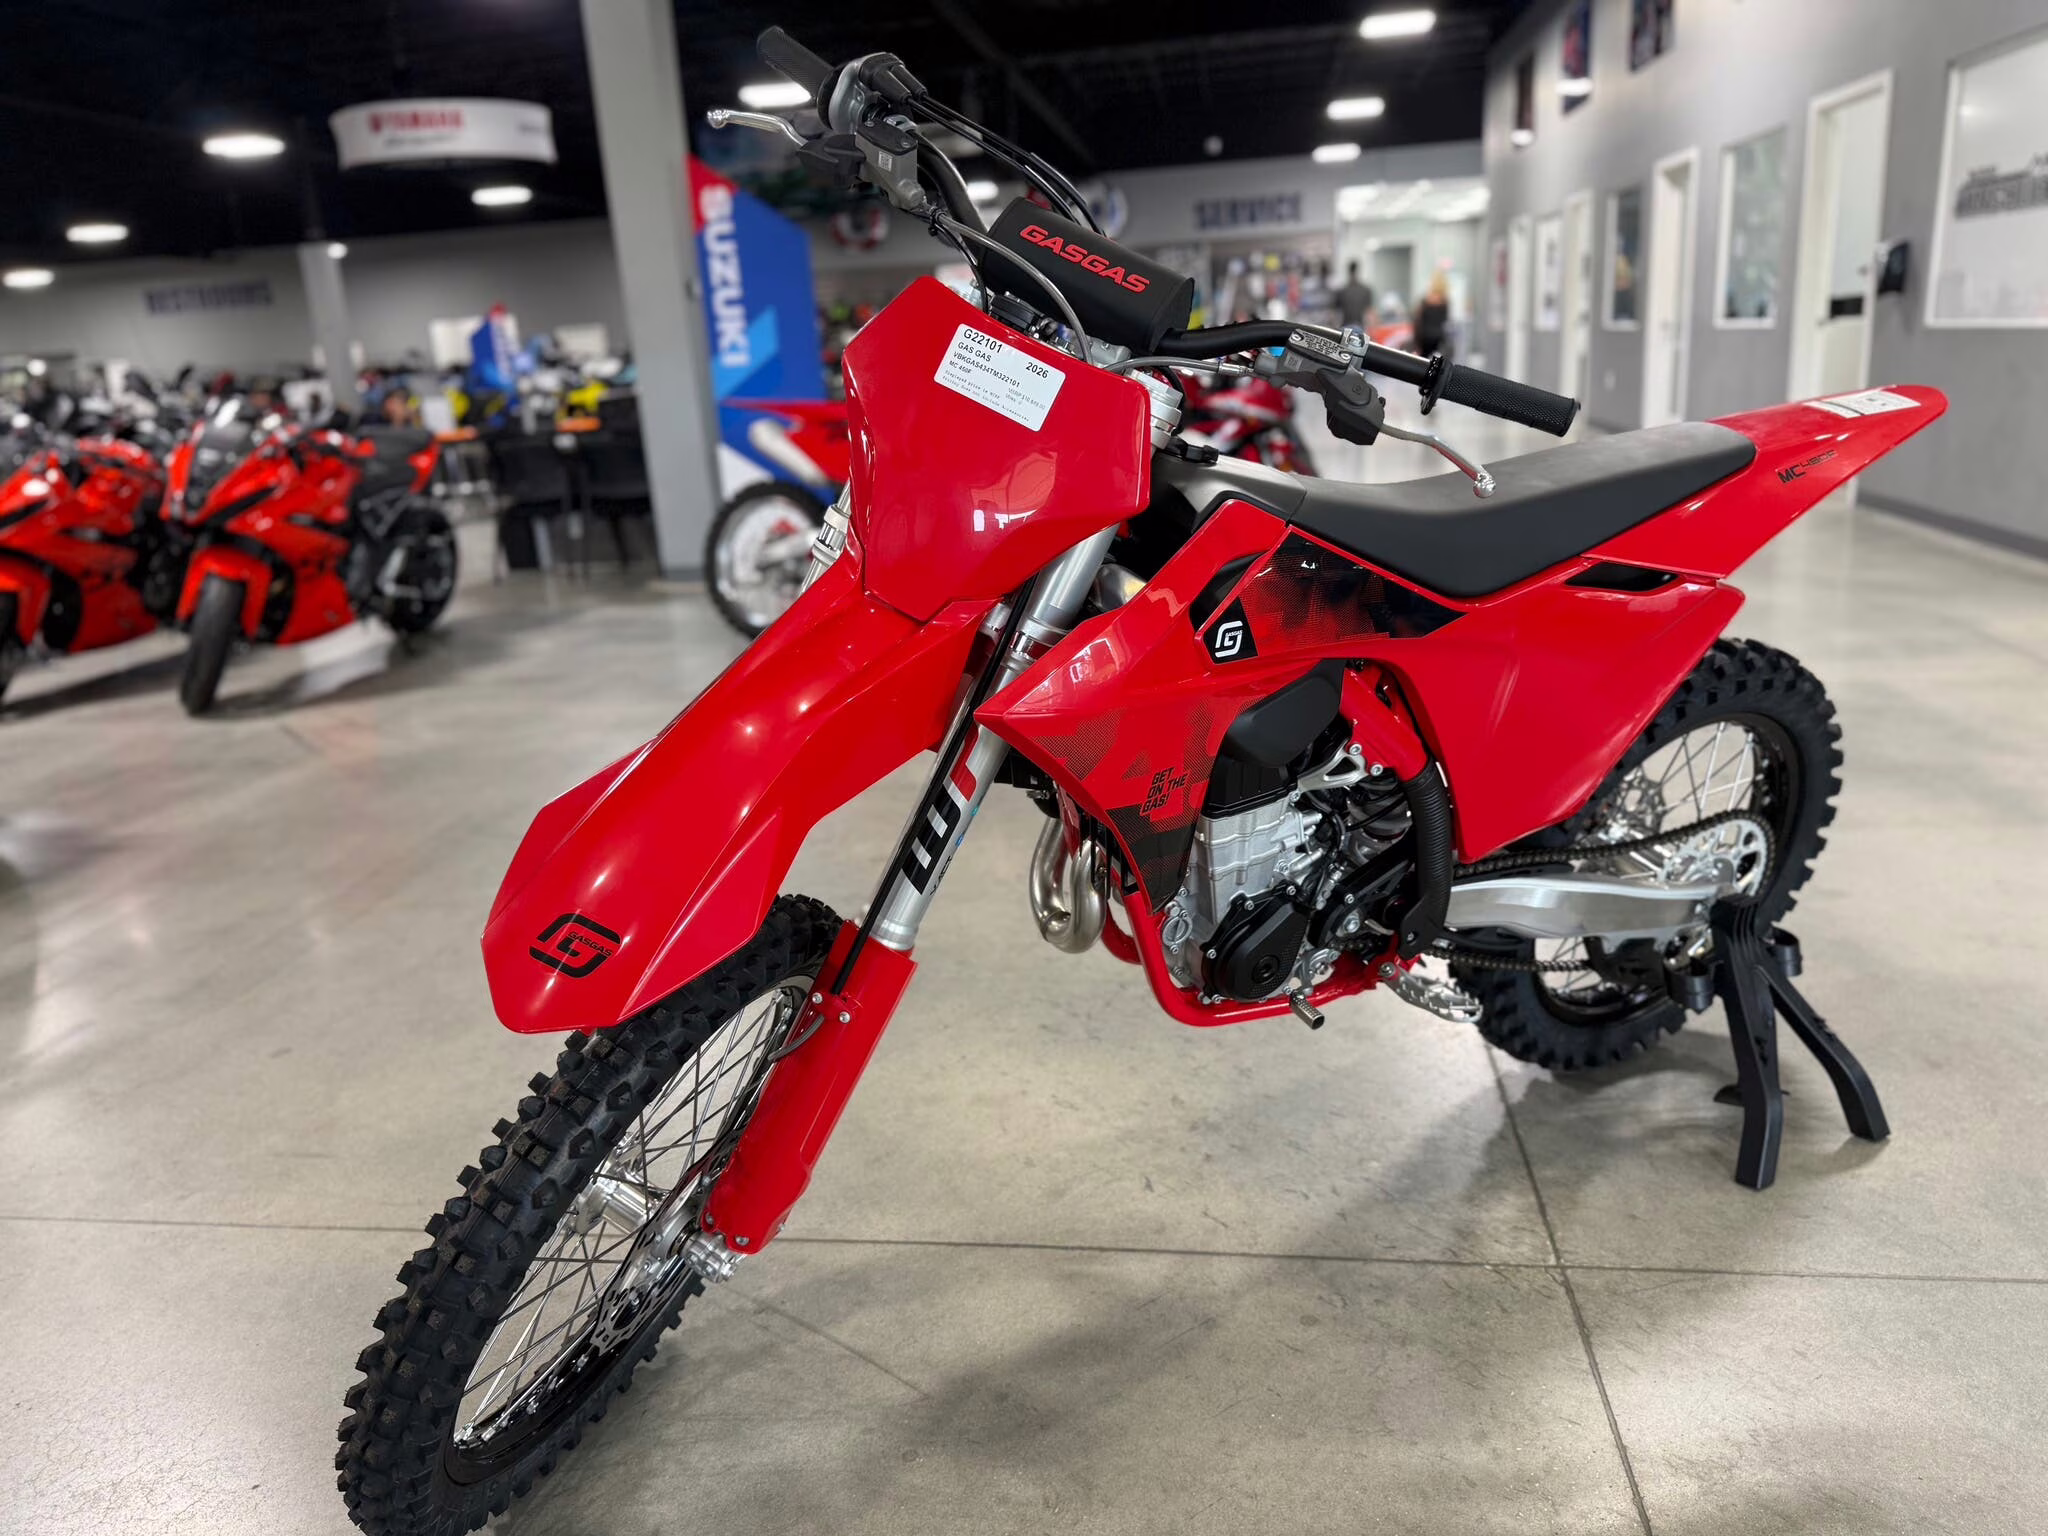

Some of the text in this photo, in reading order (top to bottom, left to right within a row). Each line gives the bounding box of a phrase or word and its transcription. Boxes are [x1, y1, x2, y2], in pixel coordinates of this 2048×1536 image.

[1020, 224, 1151, 293] GASGAS
[699, 184, 751, 368] SUZUKI
[957, 341, 992, 362] GAS GAS
[963, 327, 1003, 353] G22101
[949, 360, 958, 368] MC
[1025, 361, 1049, 378] 2026
[1147, 773, 1189, 799] ON THE
[1152, 767, 1176, 785] GET
[1142, 793, 1170, 813] GAS!
[568, 931, 614, 957] GASGAS
